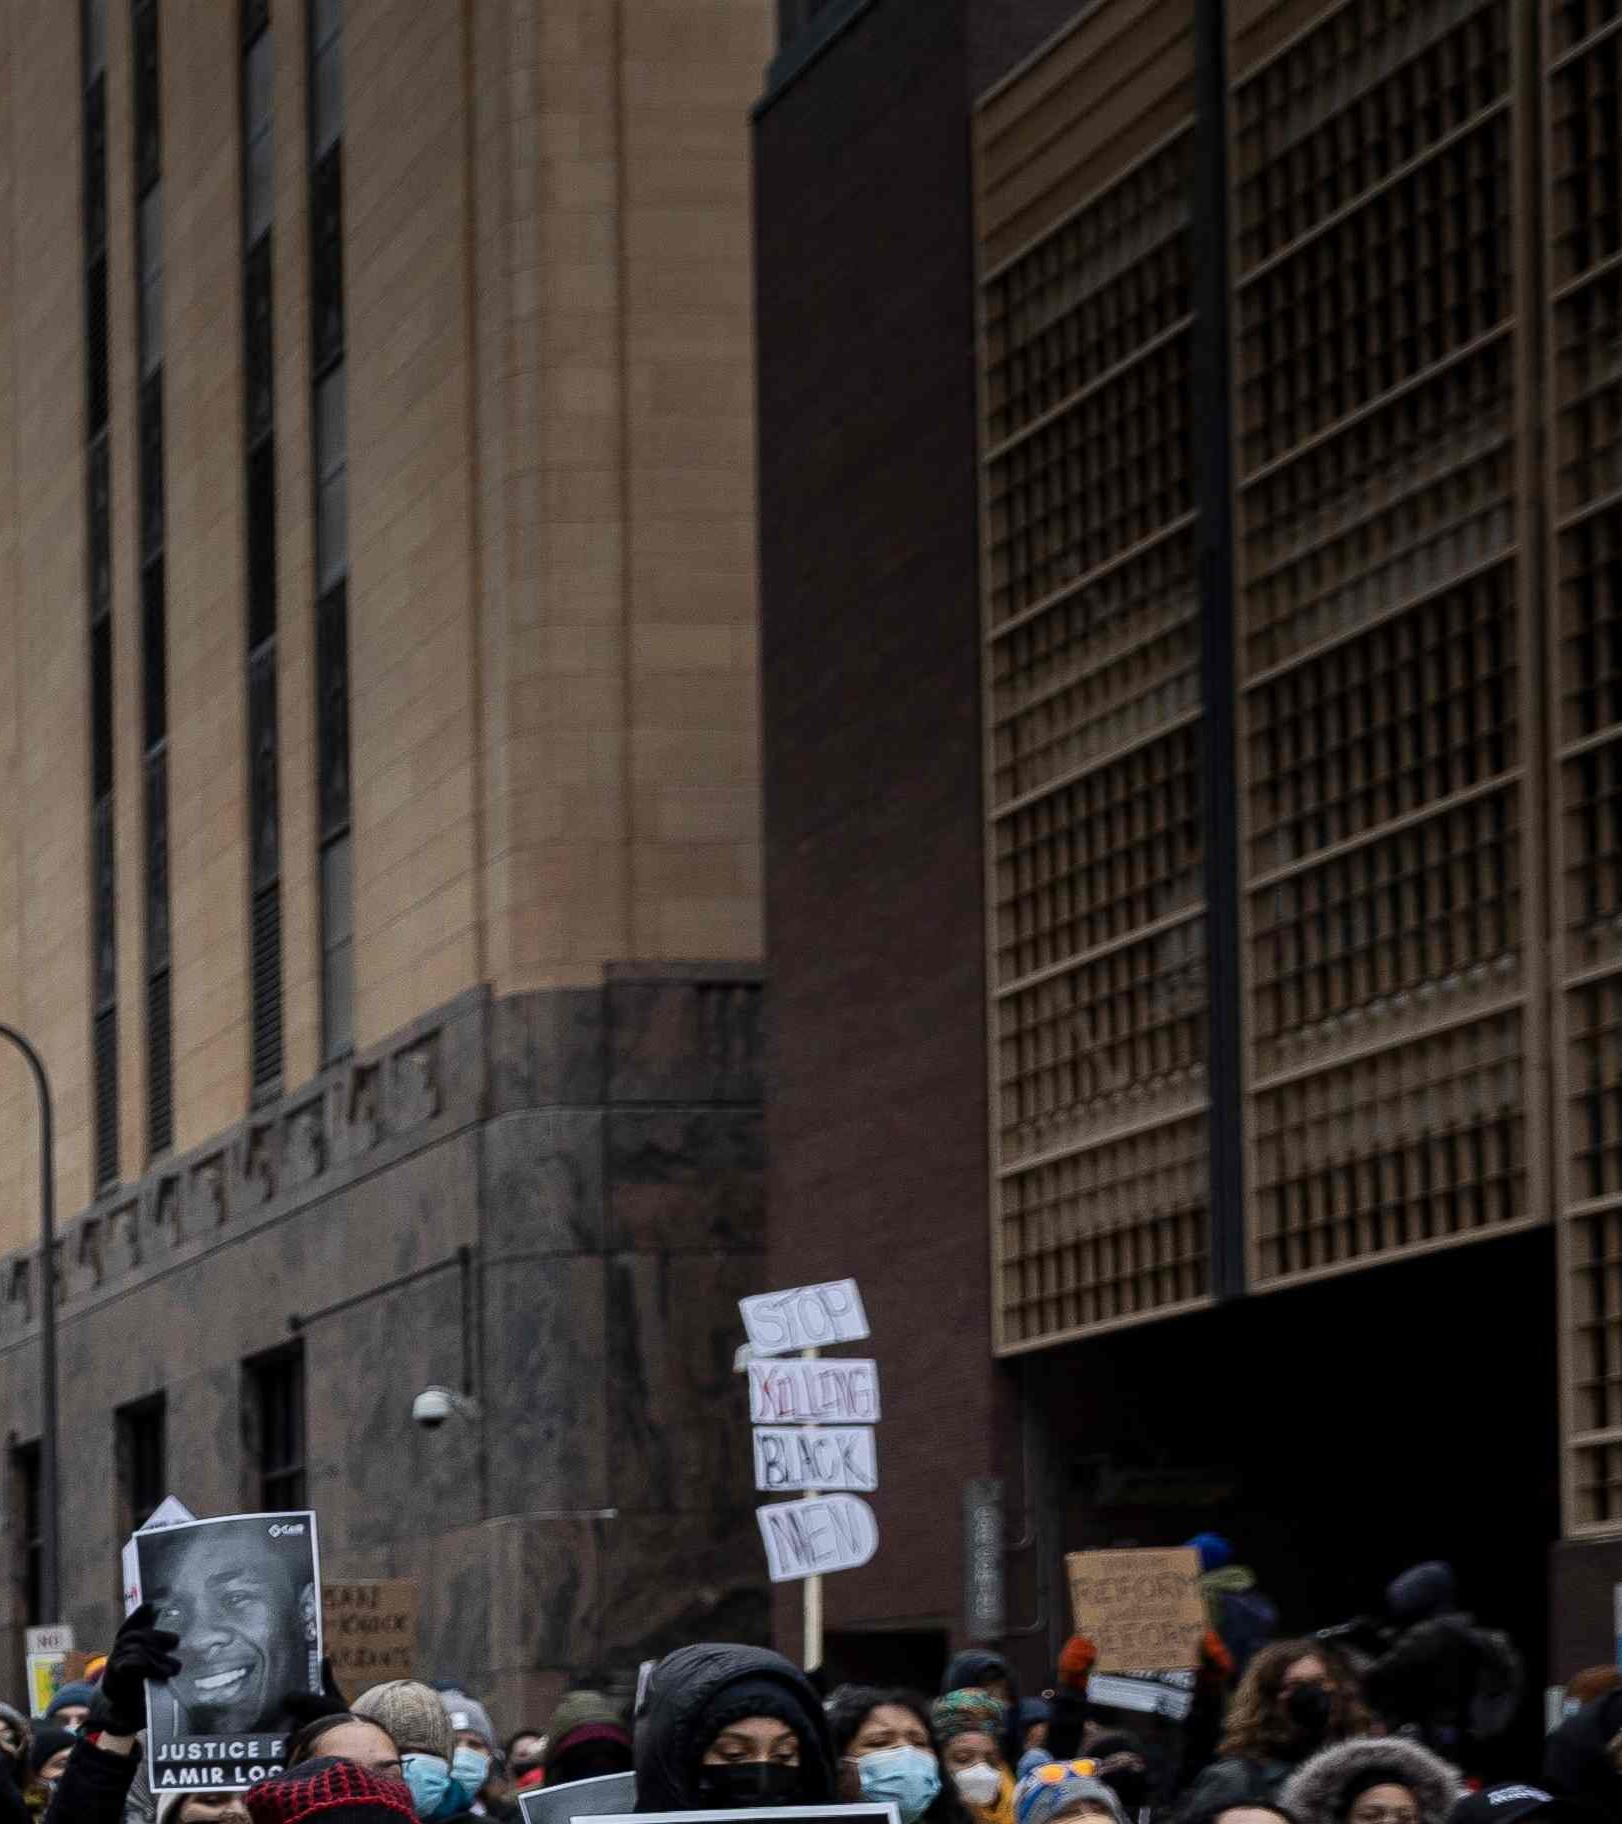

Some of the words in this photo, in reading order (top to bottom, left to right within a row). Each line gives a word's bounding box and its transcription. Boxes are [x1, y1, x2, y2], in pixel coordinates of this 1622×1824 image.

[753, 1287, 853, 1347] STOP
[756, 1364, 877, 1418] KILLING
[757, 1433, 876, 1489] BLACK
[157, 1740, 259, 1762] JUSTICE
[161, 1765, 224, 1785] AMIR
